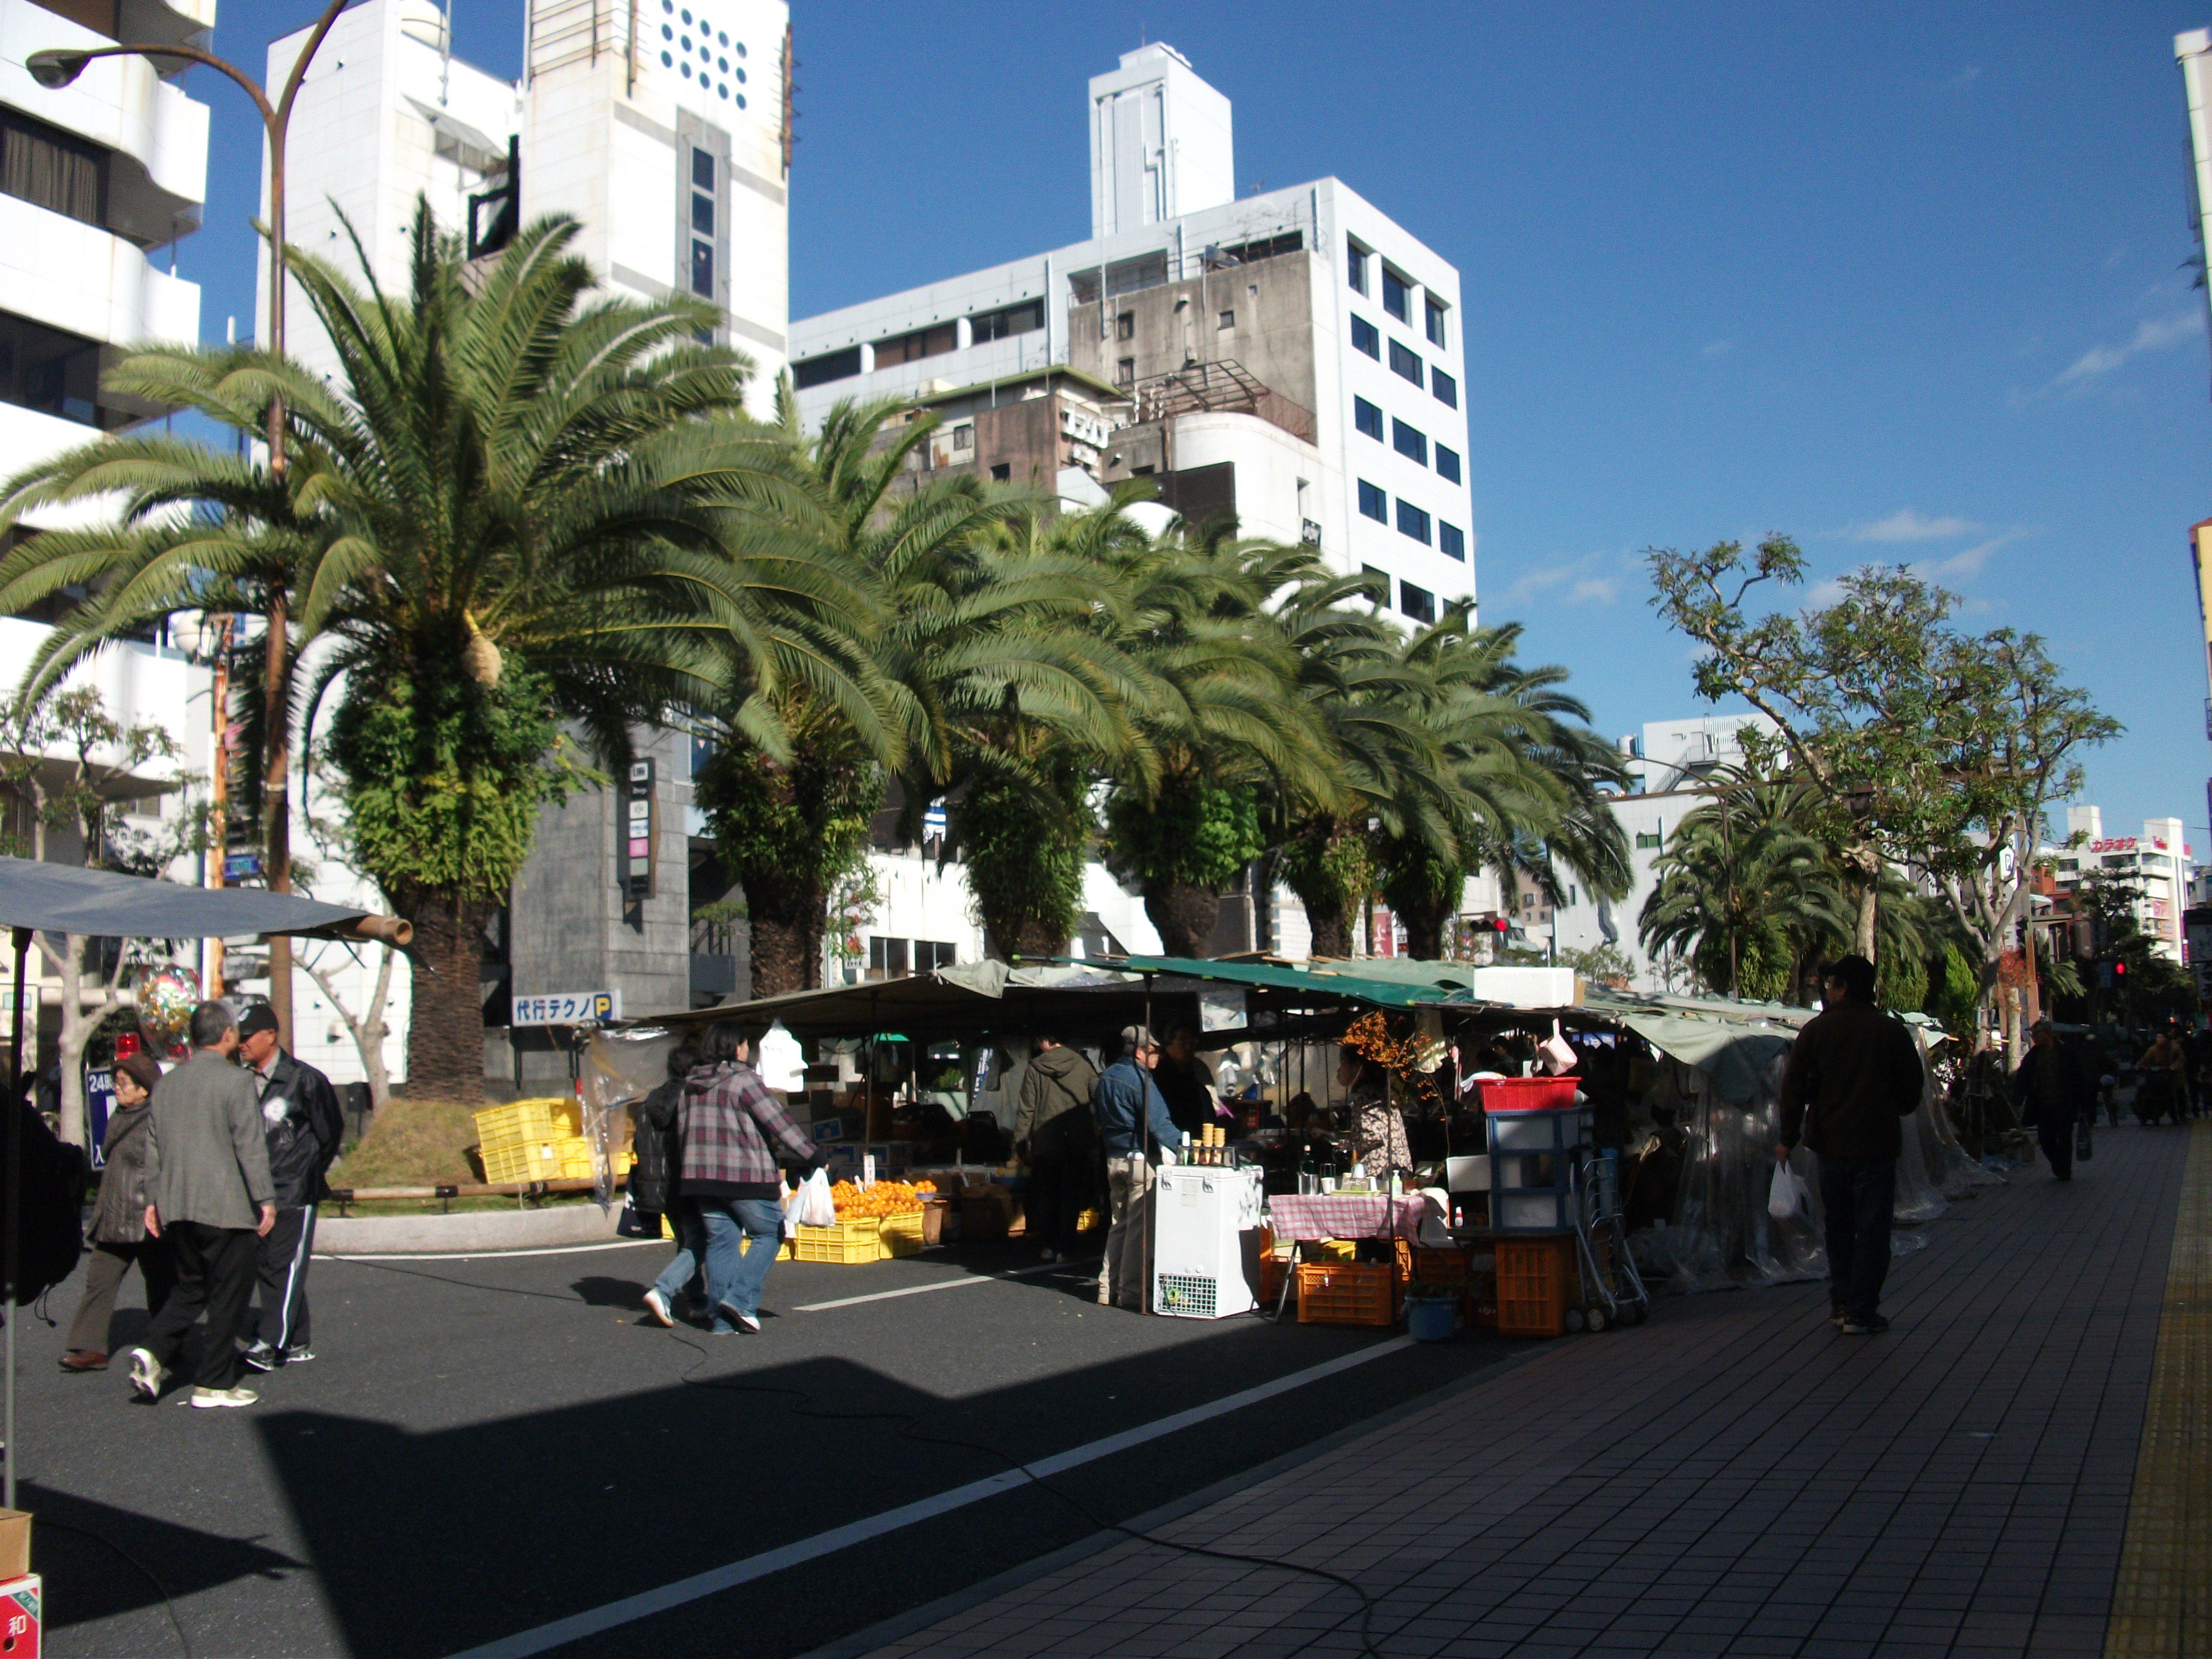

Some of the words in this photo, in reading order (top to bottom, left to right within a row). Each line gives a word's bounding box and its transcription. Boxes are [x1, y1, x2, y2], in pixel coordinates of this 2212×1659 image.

[2091, 837, 2137, 853] カラオケ
[518, 998, 590, 1021] 代行テクノ
[594, 997, 611, 1017] P
[8, 1614, 27, 1636] 和
